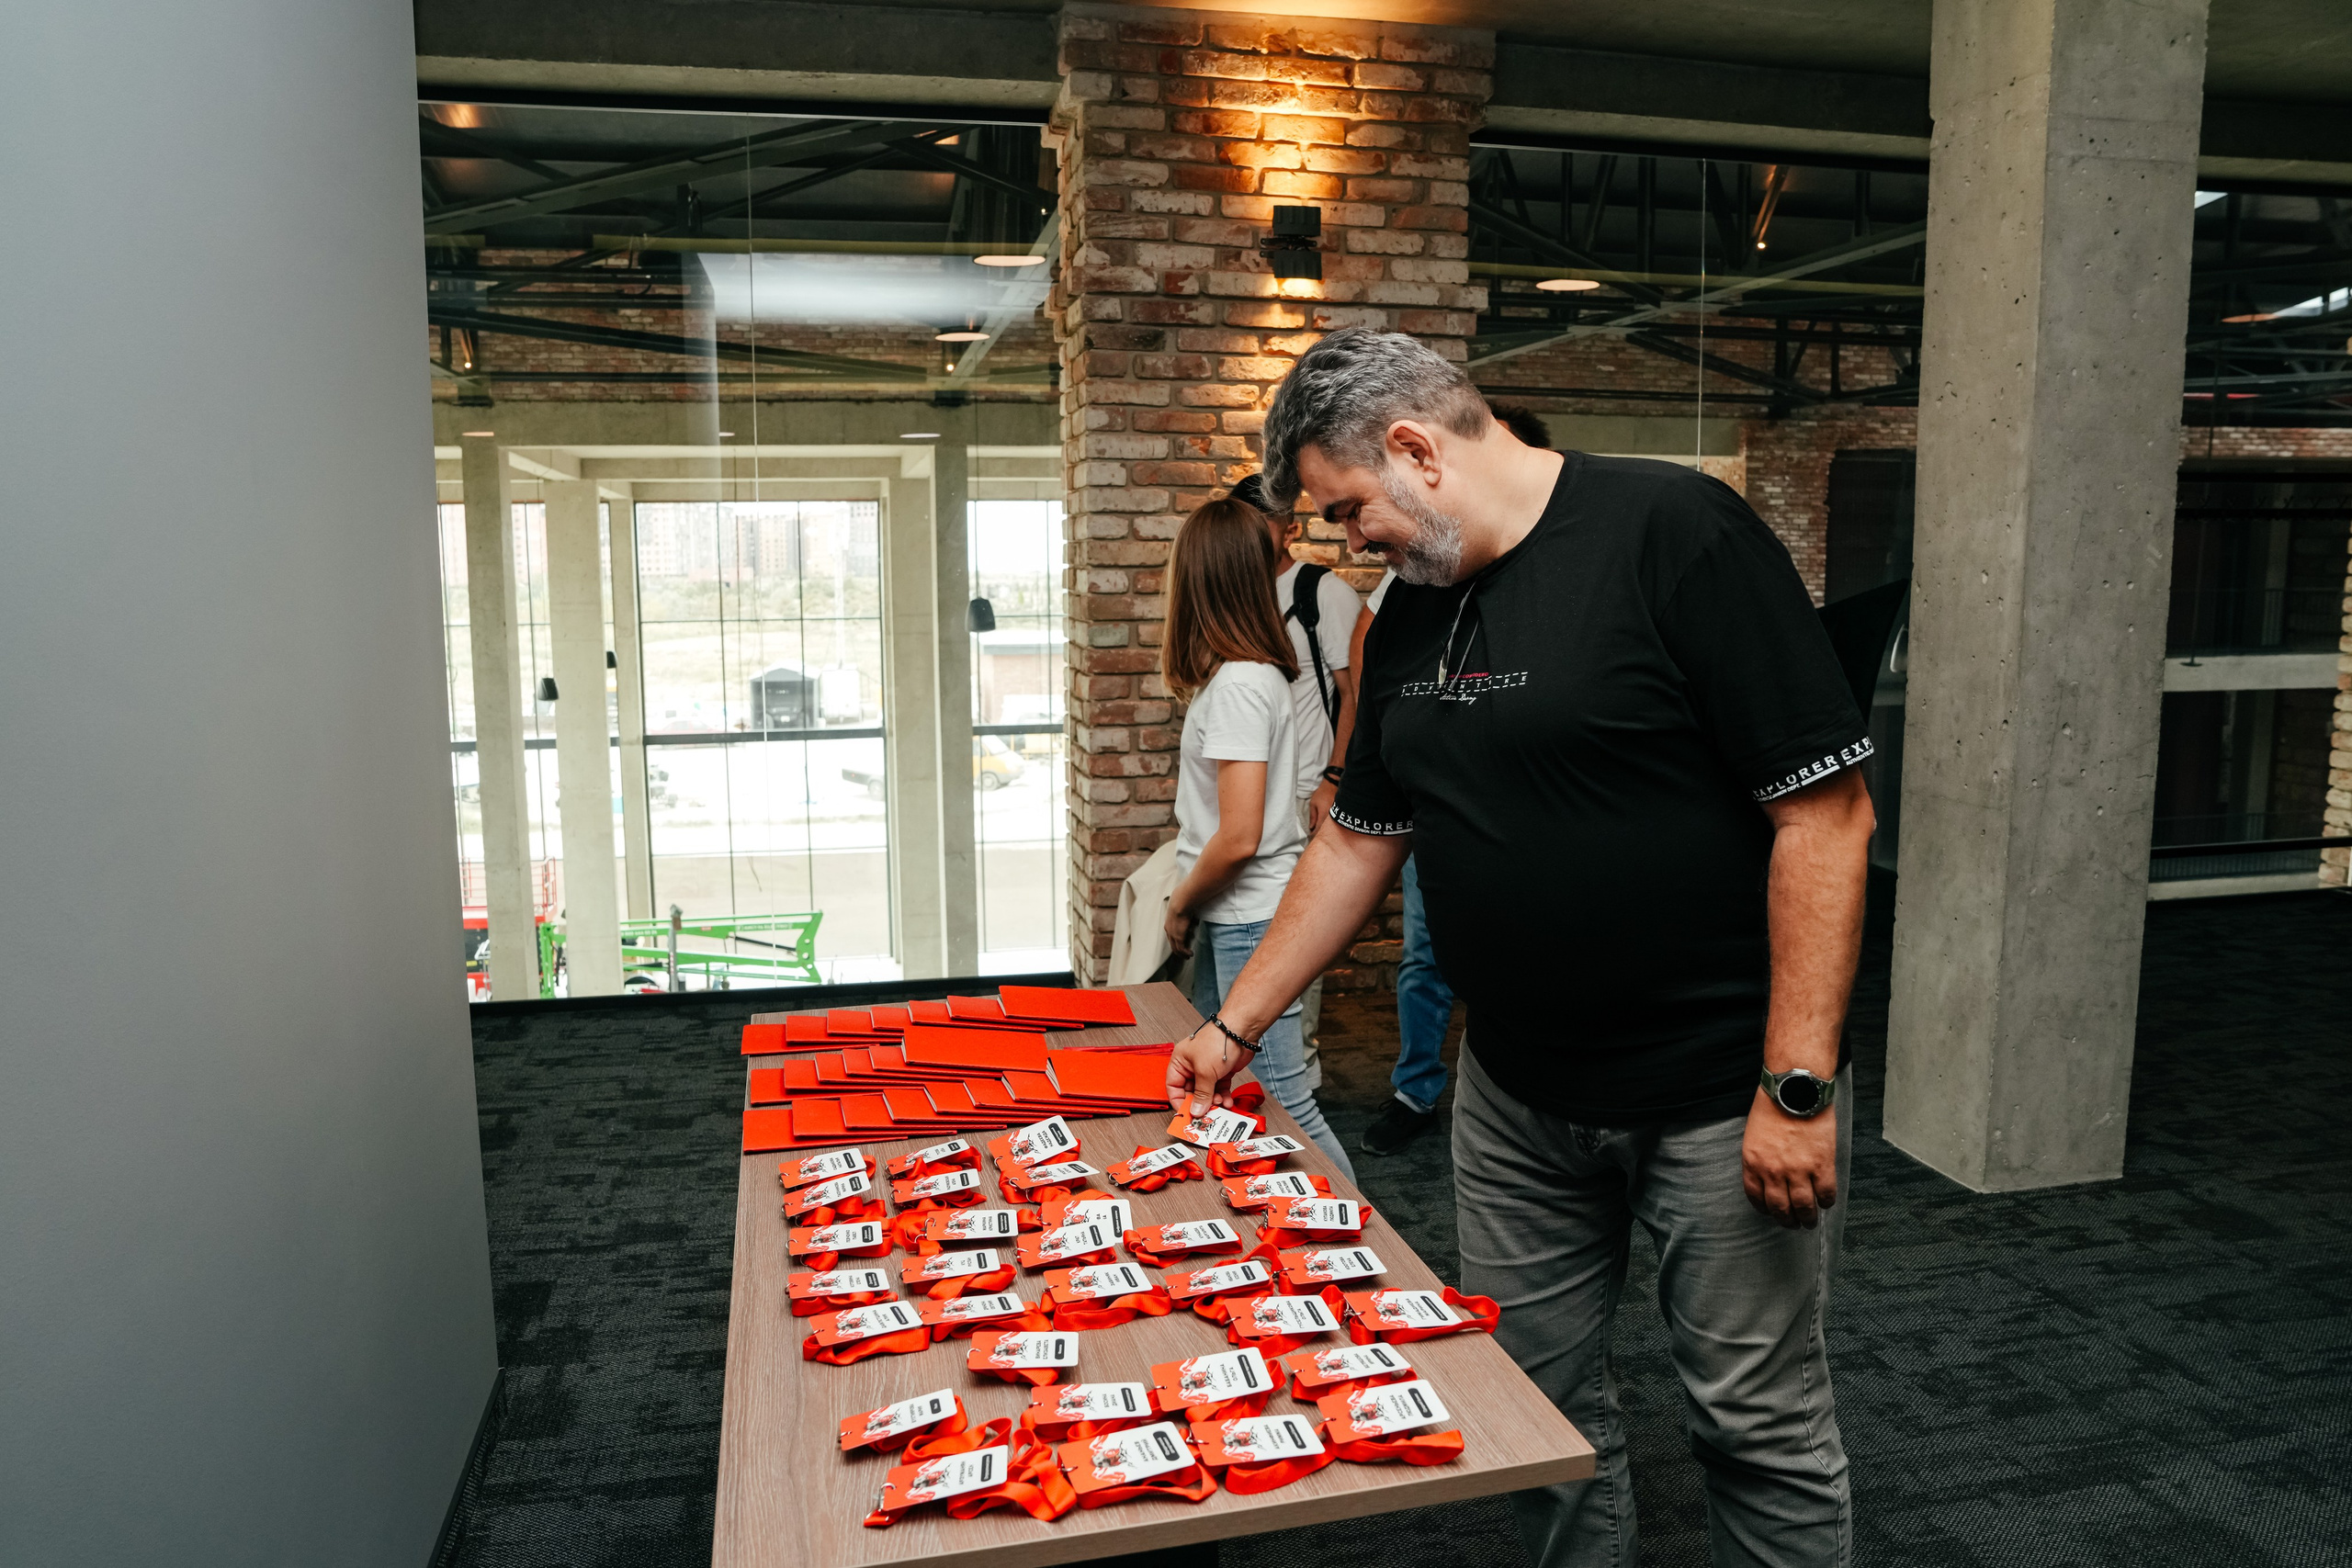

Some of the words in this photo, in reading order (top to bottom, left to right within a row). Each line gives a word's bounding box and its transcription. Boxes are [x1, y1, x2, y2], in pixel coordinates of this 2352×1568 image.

[1402, 675, 1527, 694] DVNTRE
[1840, 736, 1871, 761] EXP
[1339, 811, 1413, 831] EXPLORER
[1041, 1130, 1053, 1146] НАДЕЖДА
[1222, 1126, 1230, 1136] ОЛЕГ
[1036, 1133, 1048, 1148] ФАДЕЕВА
[1228, 1367, 1238, 1381] ОЛЬГА
[1140, 1438, 1157, 1461] ДМИТРИЙ
